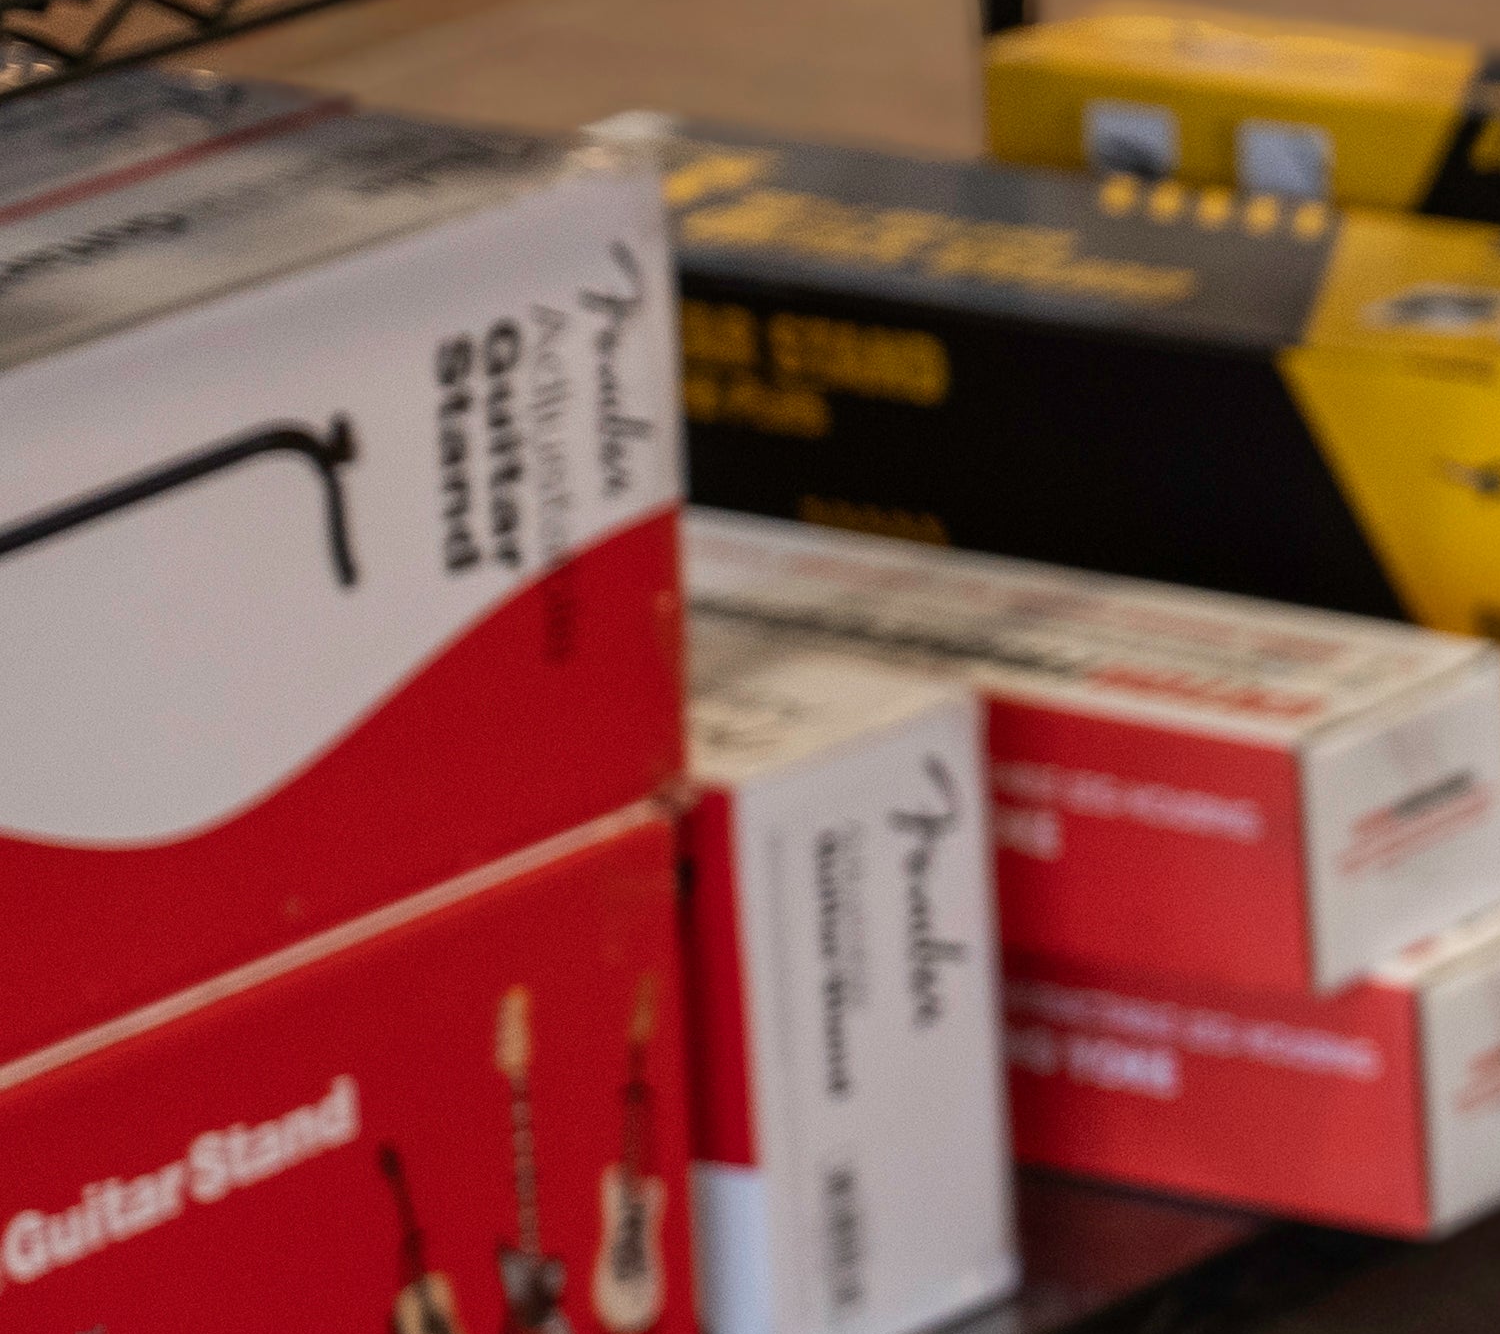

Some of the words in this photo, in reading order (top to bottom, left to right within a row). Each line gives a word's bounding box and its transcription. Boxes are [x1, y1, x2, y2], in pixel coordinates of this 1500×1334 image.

[436, 333, 480, 573] Stand
[484, 318, 524, 565] Guitar
[579, 239, 654, 499] Fender
[889, 755, 970, 1029] Fender
[3, 1161, 185, 1284] Guitar
[187, 1073, 361, 1204] Stand
